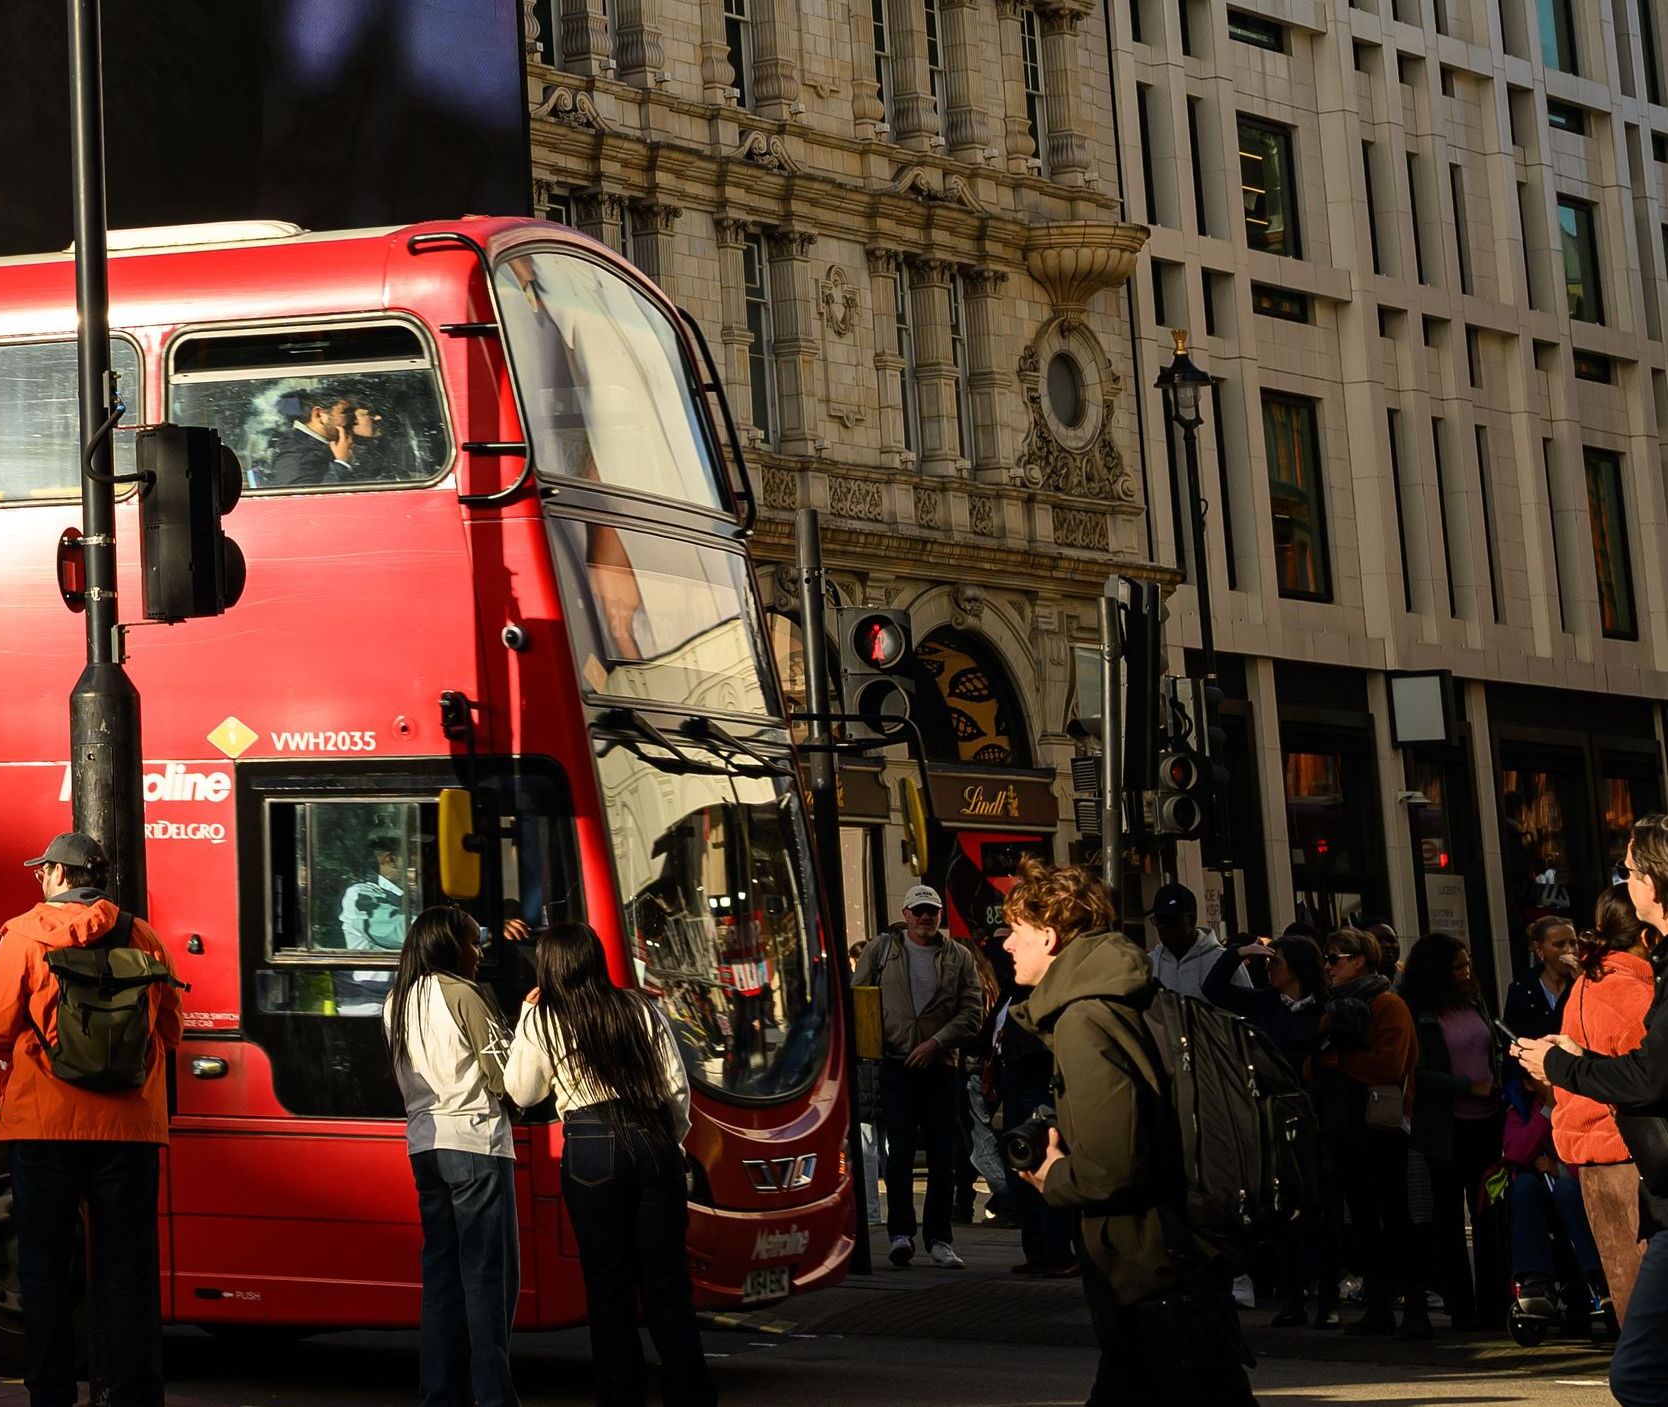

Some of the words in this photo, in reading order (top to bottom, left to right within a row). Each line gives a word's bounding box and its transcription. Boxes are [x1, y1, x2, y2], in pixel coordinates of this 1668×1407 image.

[271, 730, 377, 752] VWH2035
[58, 762, 233, 803] oline
[959, 783, 1007, 817] Lindt
[144, 819, 228, 844] RTDELGRO
[235, 1290, 262, 1302] PUSH
